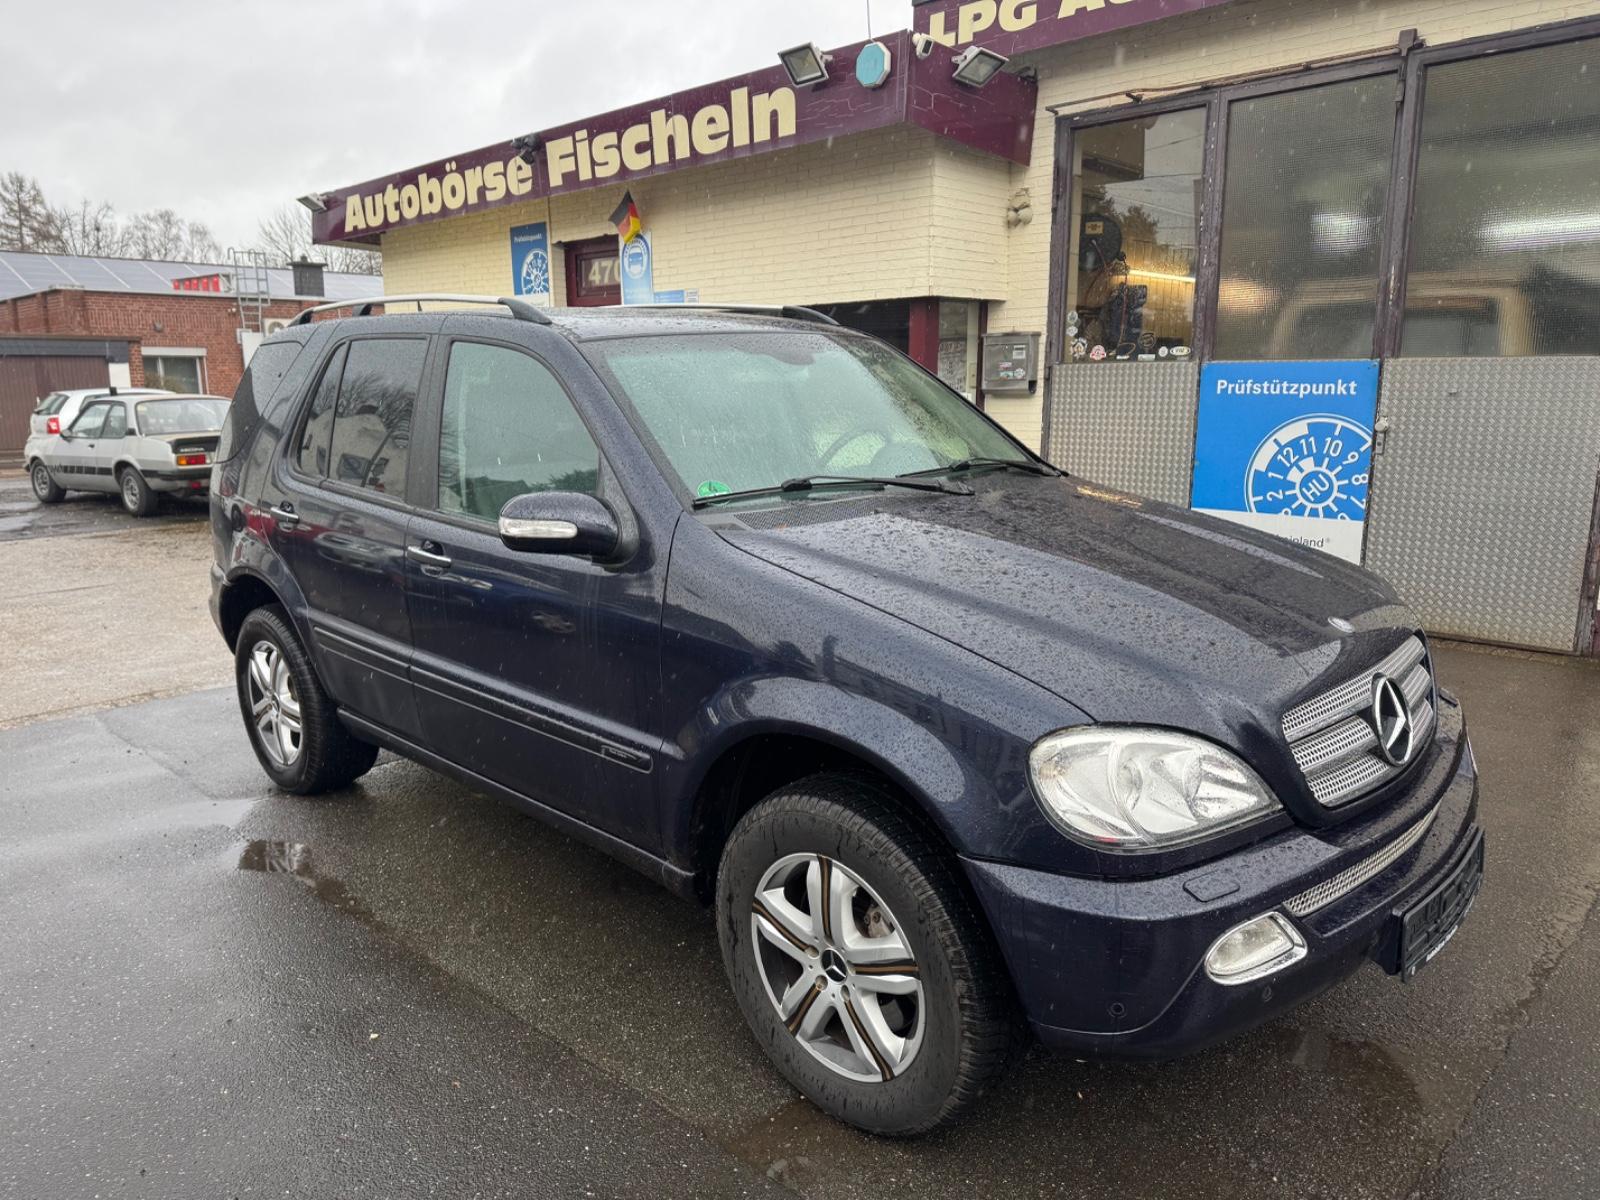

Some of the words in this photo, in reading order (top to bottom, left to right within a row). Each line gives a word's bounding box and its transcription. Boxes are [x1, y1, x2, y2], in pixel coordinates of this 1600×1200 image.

[929, 0, 1037, 48] LPG
[344, 155, 533, 233] Autobörse
[546, 86, 797, 188] Fischeln
[1216, 379, 1358, 399] Prüfstützpunkt
[1300, 436, 1317, 455] 11
[1323, 437, 1343, 457] 10
[1277, 447, 1299, 468] 12
[1342, 451, 1359, 465] 9
[1302, 473, 1330, 502] HU
[1351, 473, 1368, 486] 8
[1266, 489, 1284, 502] 2
